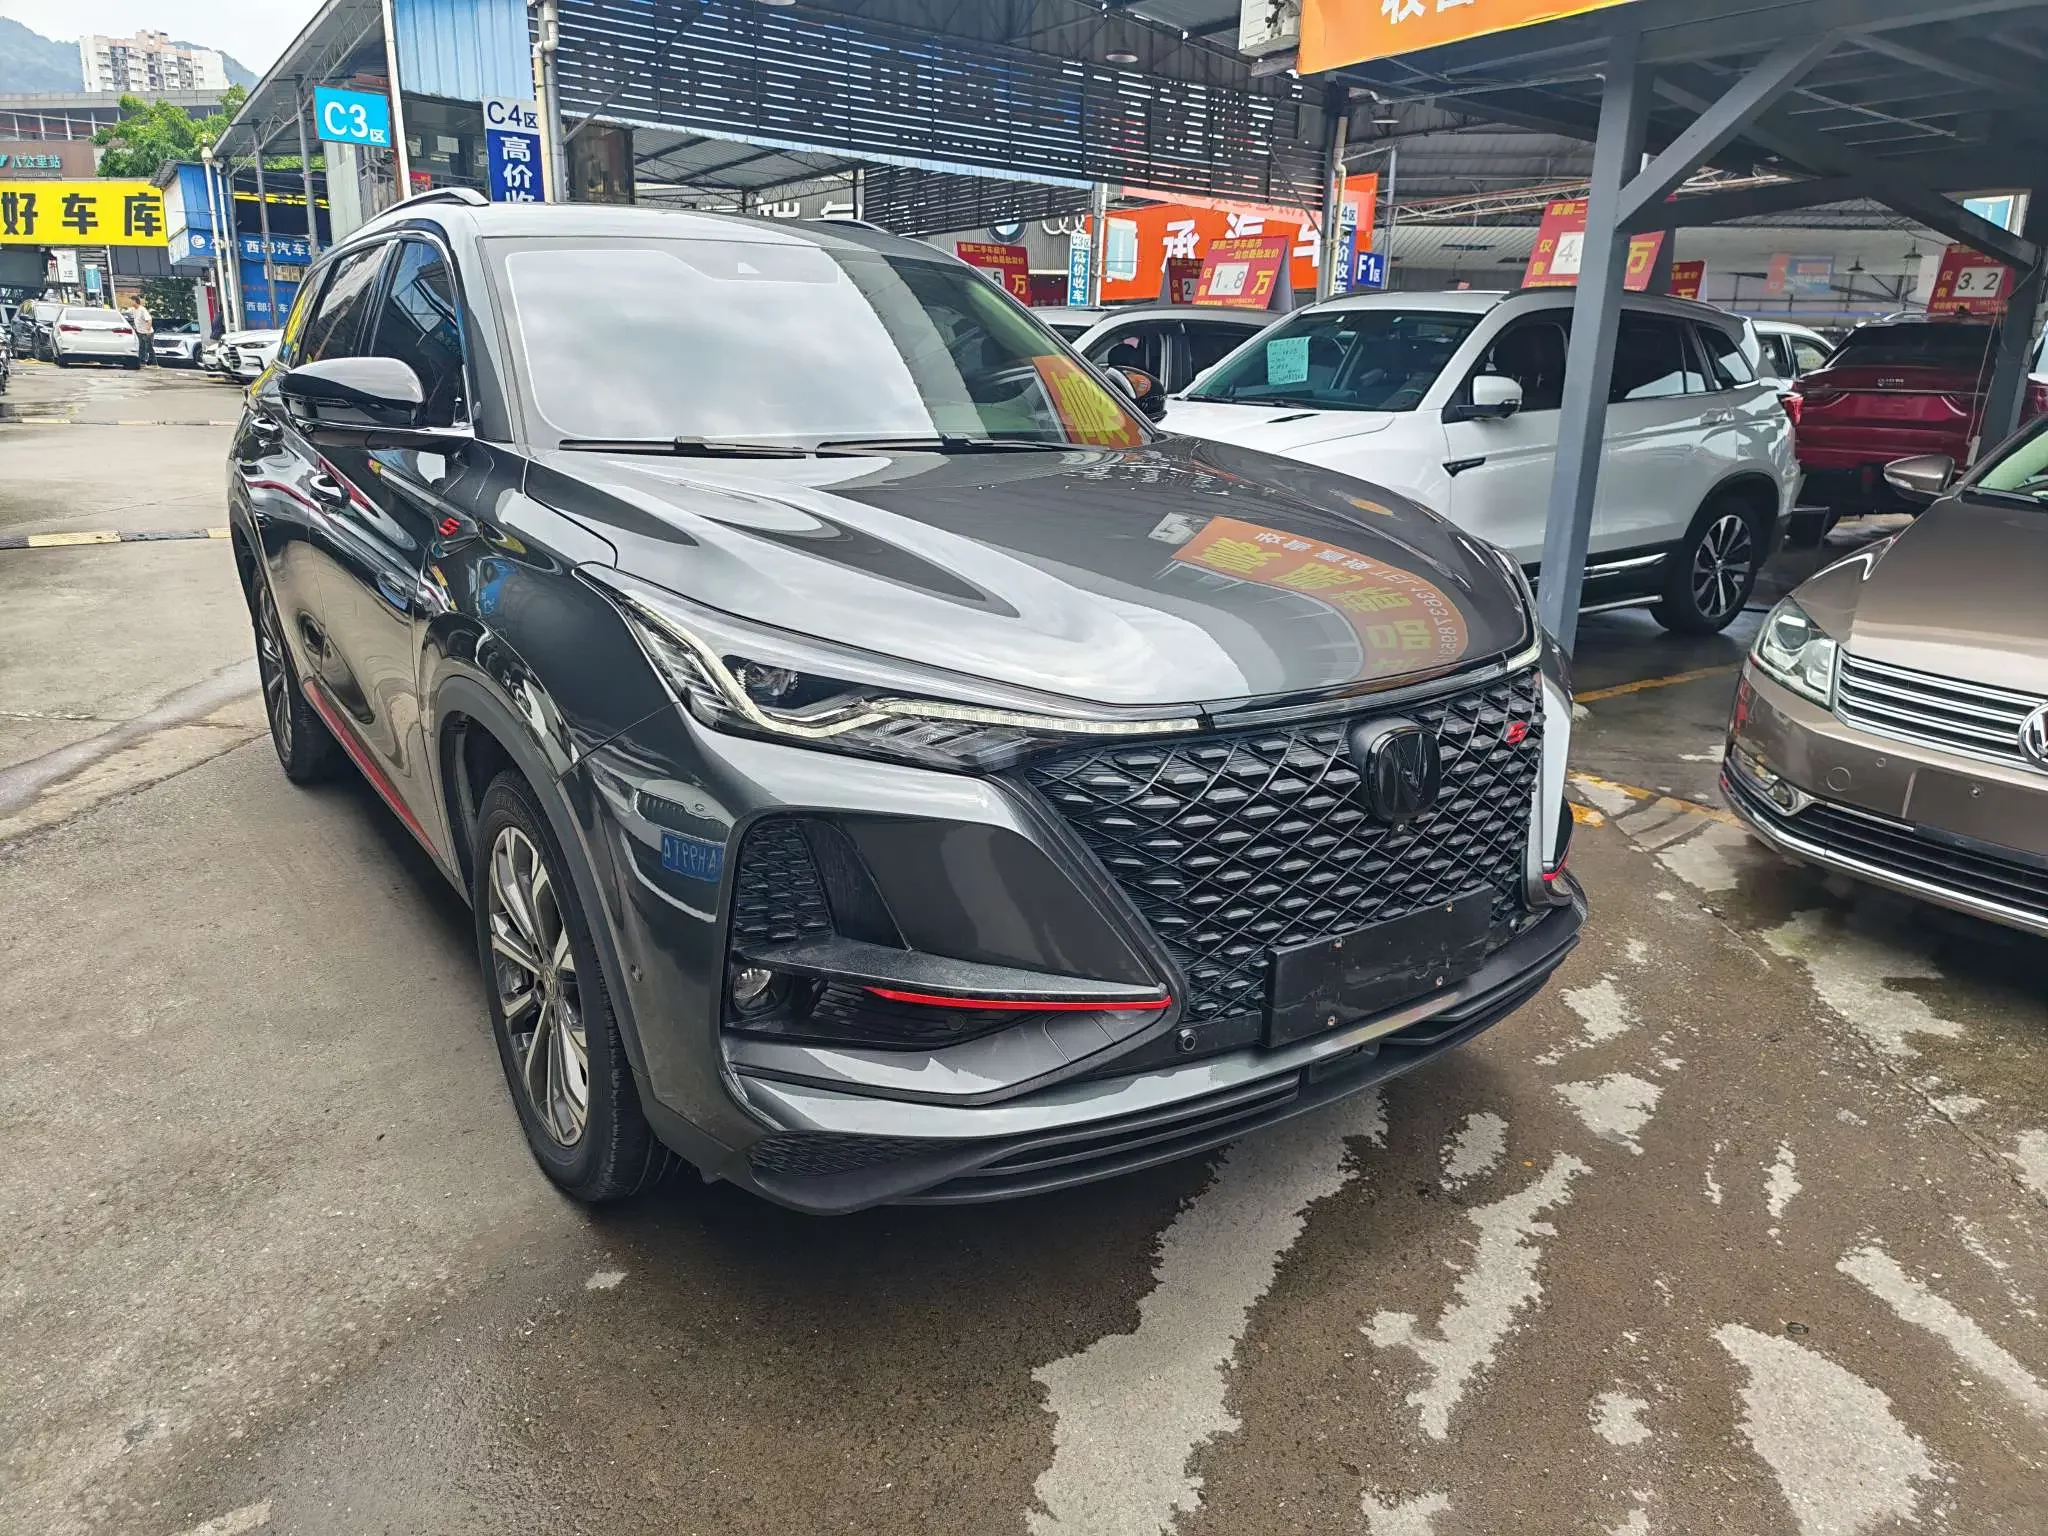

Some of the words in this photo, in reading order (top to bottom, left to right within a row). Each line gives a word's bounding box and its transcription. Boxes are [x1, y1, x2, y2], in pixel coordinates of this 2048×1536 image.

[323, 101, 387, 143] C3区
[487, 101, 539, 129] C4区
[2, 192, 162, 237] 好车库
[1215, 270, 1246, 289] 1.8
[1357, 254, 1381, 283] F1区
[1958, 272, 1999, 291] 3.2
[1011, 274, 1027, 295] 万
[1251, 270, 1275, 295] 万
